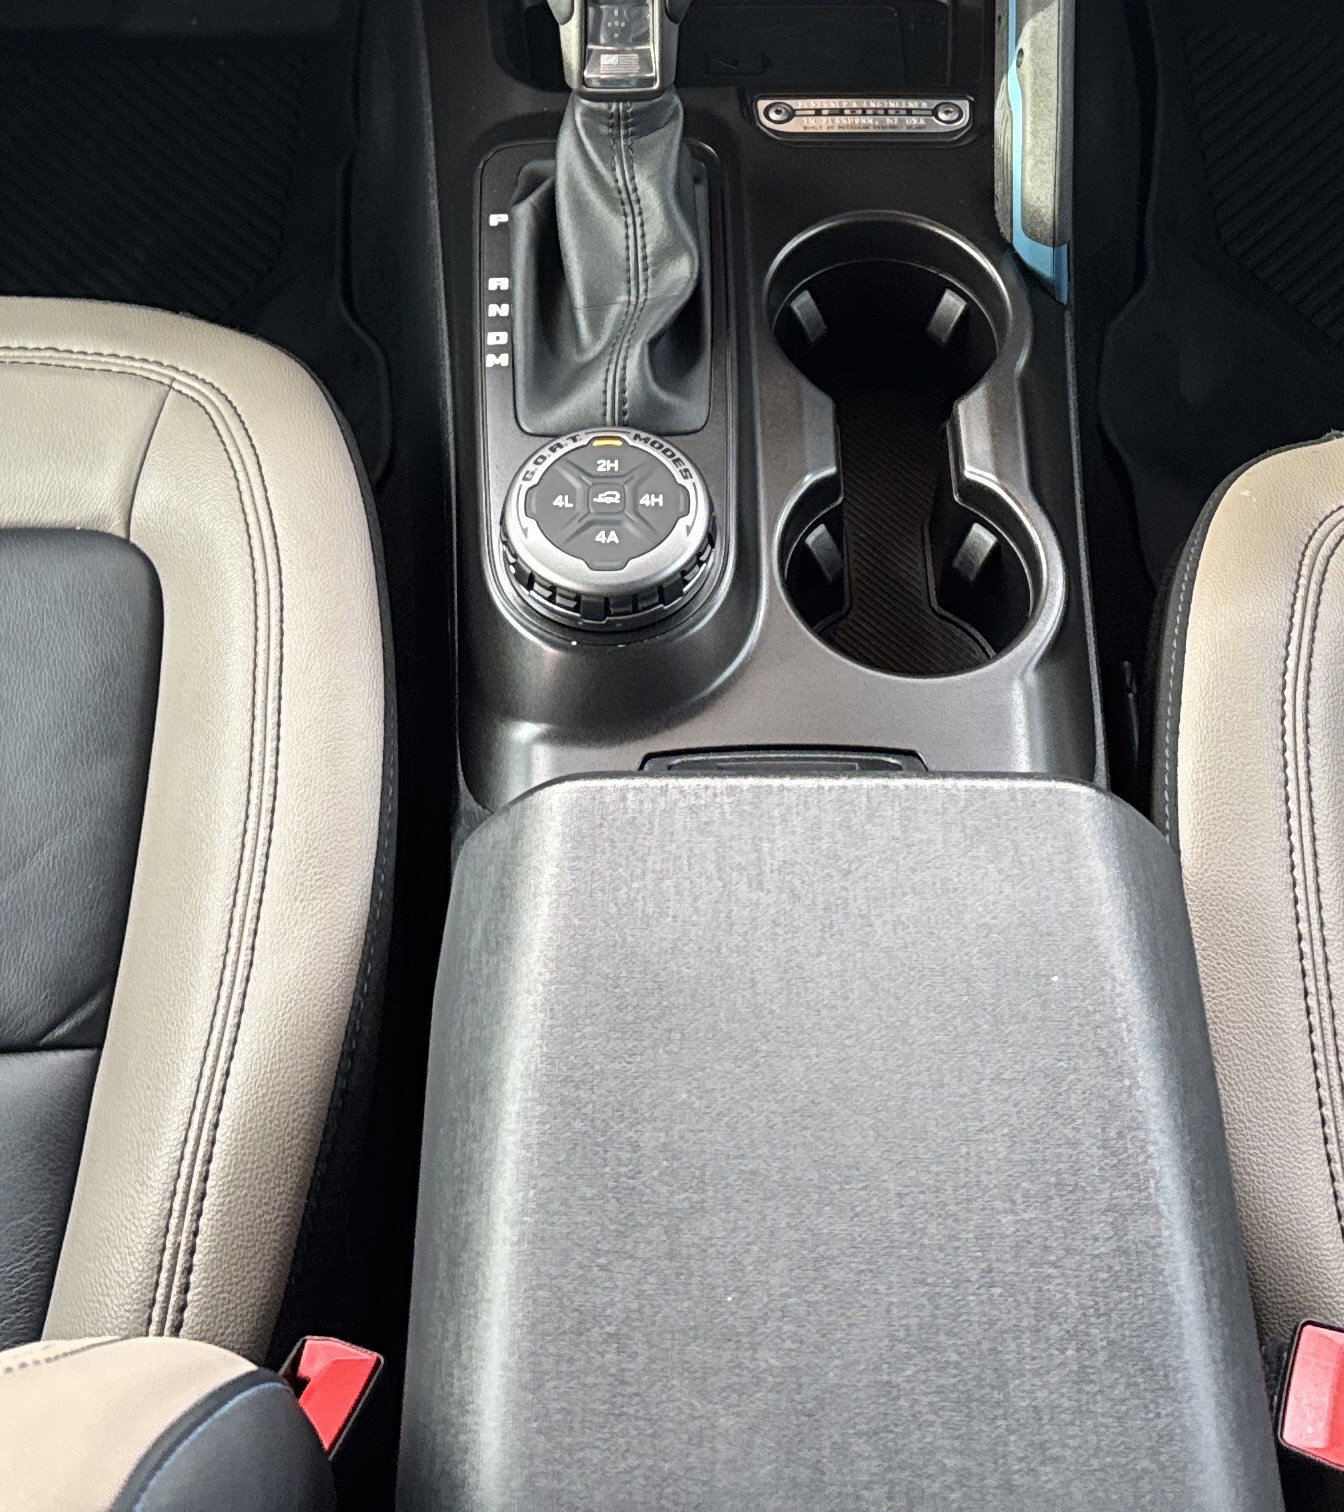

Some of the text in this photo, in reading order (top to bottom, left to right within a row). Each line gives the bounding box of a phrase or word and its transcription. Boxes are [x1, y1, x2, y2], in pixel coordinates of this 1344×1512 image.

[489, 214, 508, 226] P
[488, 304, 509, 317] N
[487, 332, 508, 345] D
[485, 353, 509, 367] M
[632, 433, 694, 481] MODES
[596, 459, 619, 472] 2H
[552, 495, 573, 507] 4L
[639, 494, 663, 506] 4H
[594, 531, 619, 543] 4A
